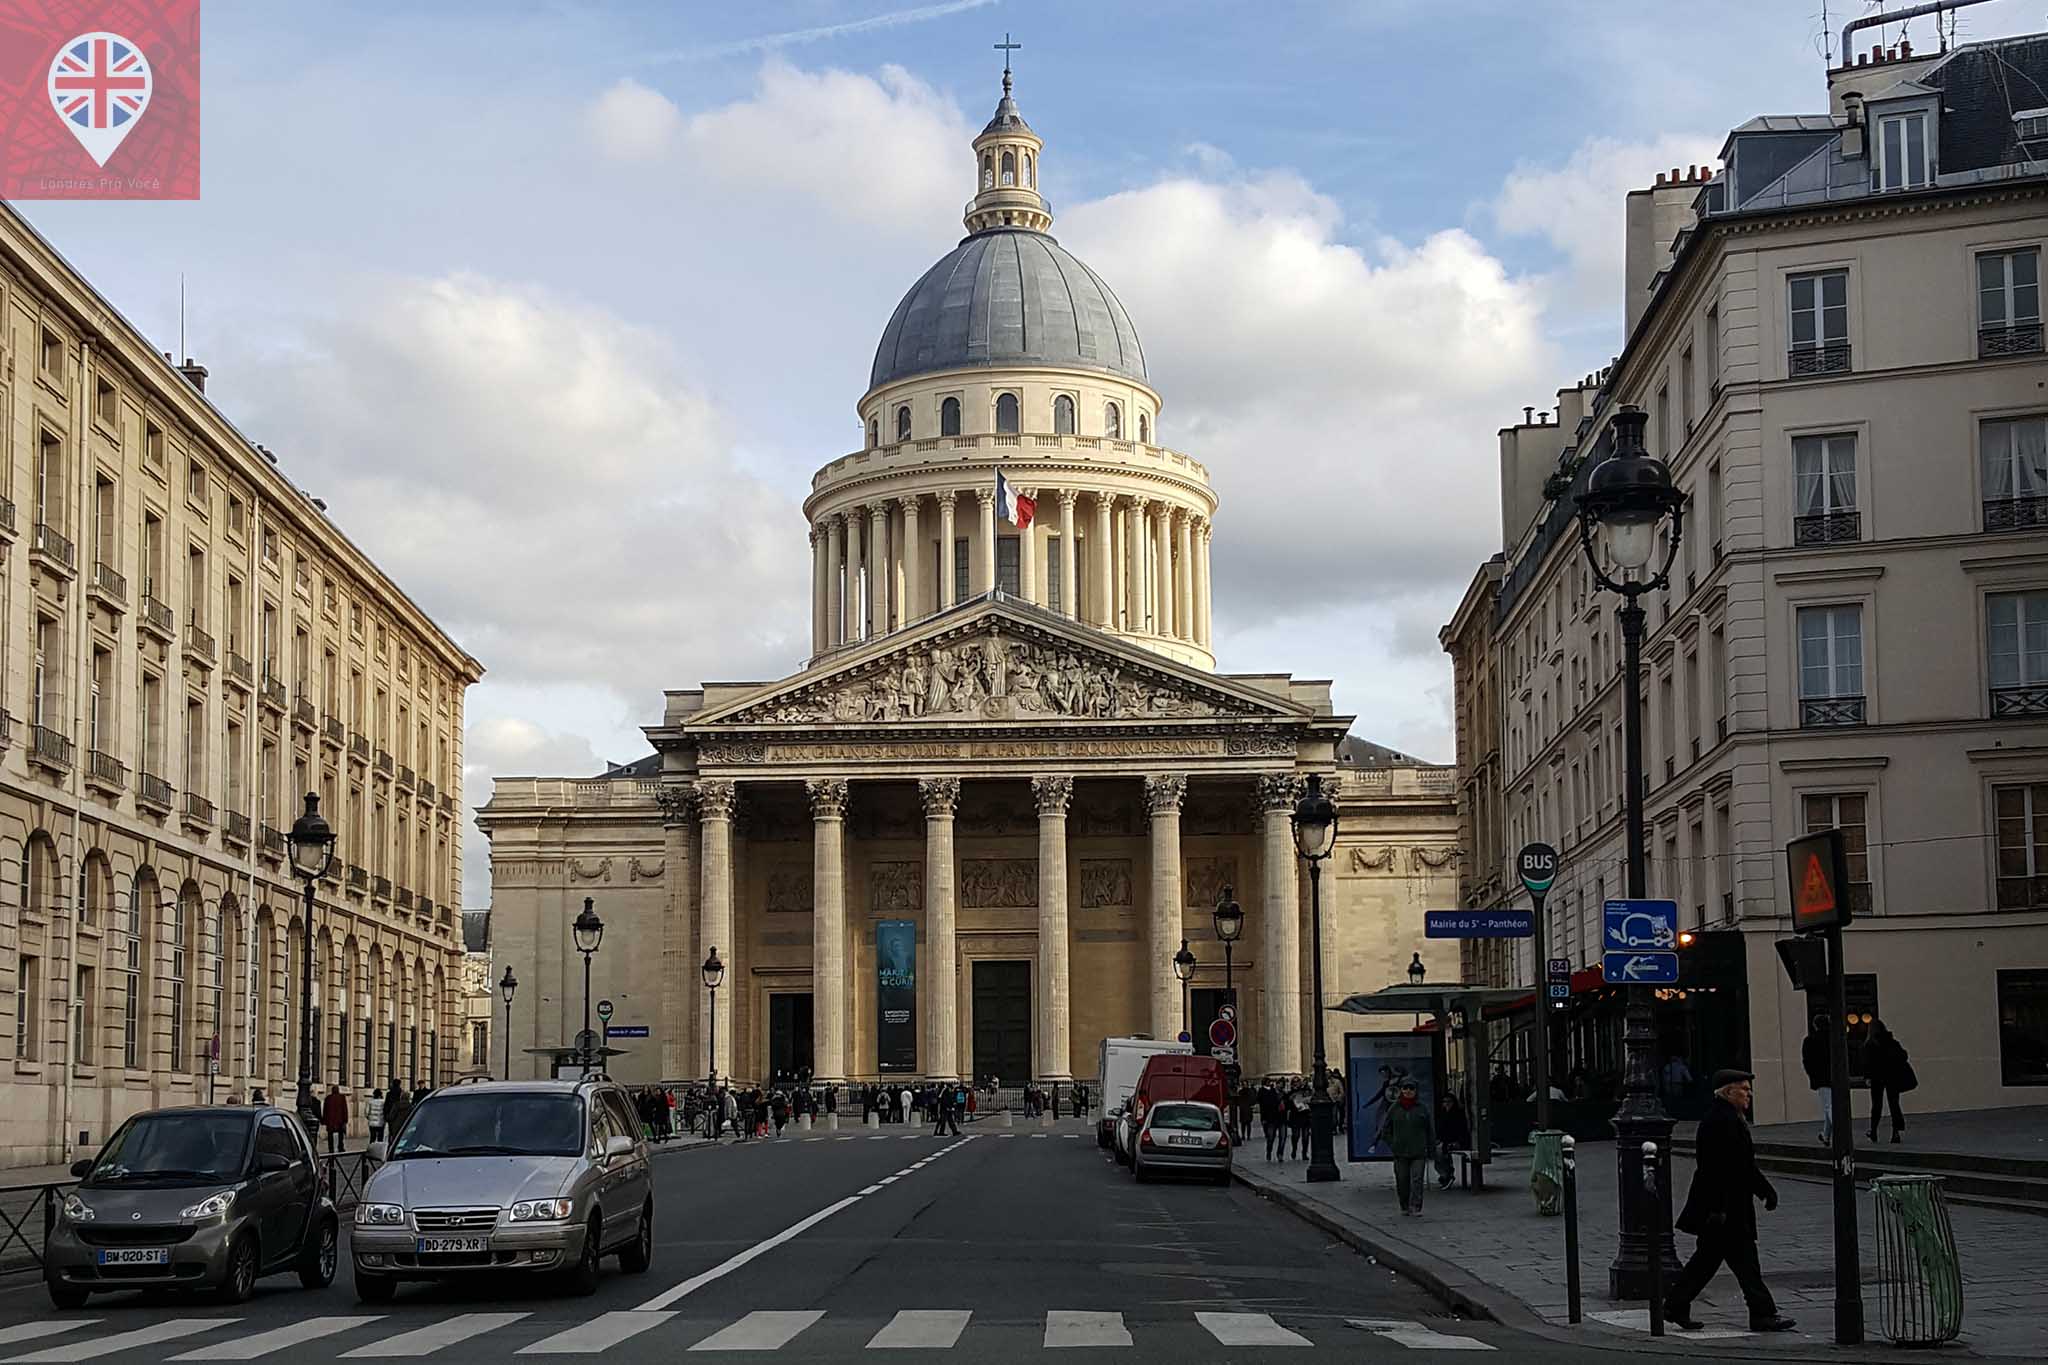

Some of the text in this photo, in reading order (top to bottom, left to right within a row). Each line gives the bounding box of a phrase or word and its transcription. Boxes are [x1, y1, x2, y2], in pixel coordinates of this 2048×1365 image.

[771, 740, 1219, 761] AUX GRANDS HOMMES LA PATRIE RECONNAISSANTE
[1523, 854, 1553, 869] BUS
[1430, 919, 1457, 929] Mairie
[1458, 919, 1470, 929] du
[1488, 919, 1528, 929] Panthéon
[1551, 961, 1567, 972] 84
[1552, 985, 1567, 996] 89
[425, 1239, 480, 1251] DD-279-XR
